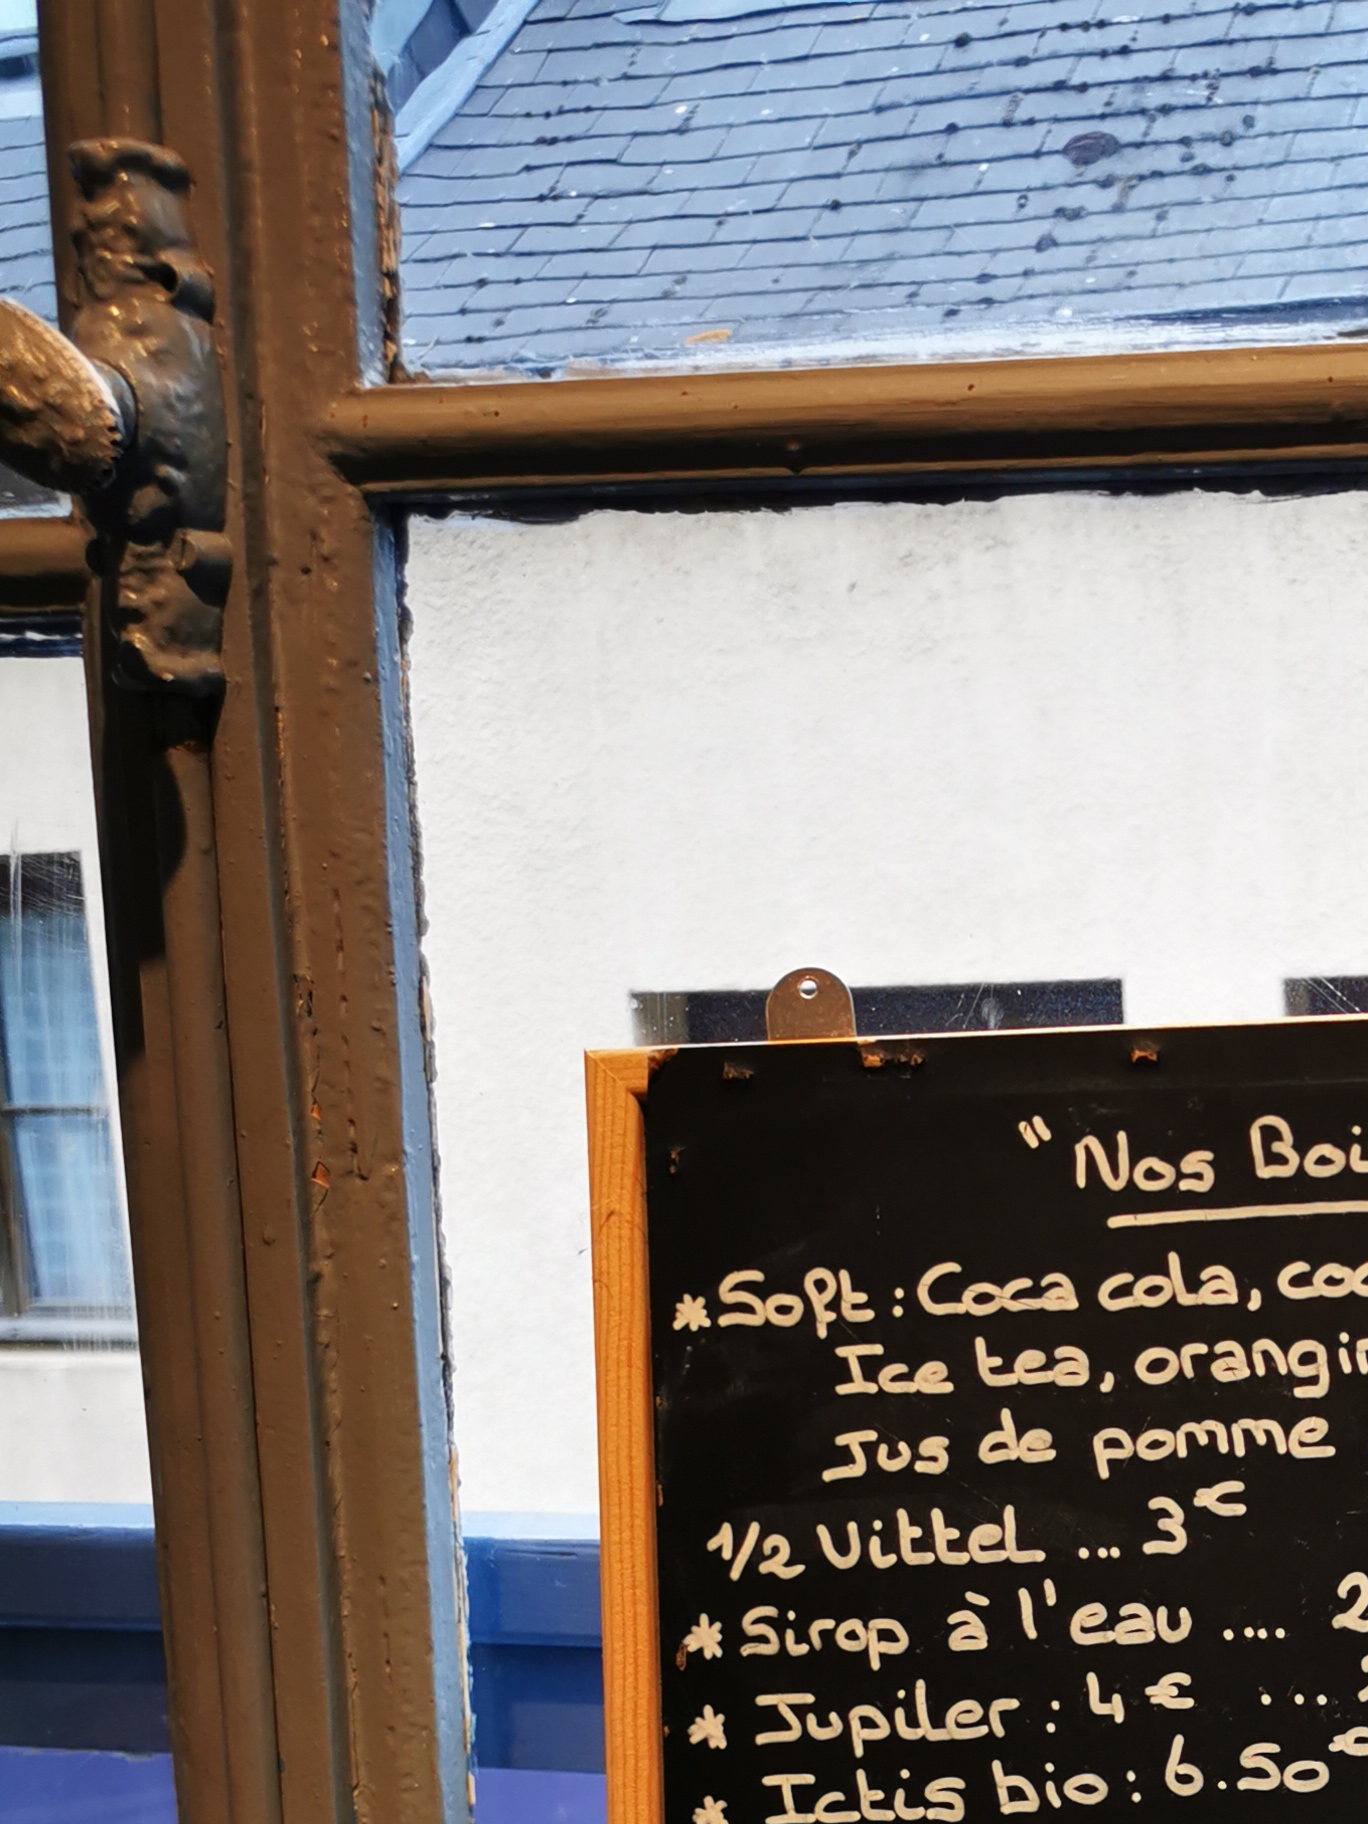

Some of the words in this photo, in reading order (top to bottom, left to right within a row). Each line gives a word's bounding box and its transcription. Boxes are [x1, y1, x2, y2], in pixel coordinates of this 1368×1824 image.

[917, 1262, 1079, 1316] Coca
[1098, 1251, 1261, 1311] cola,
[835, 1344, 954, 1395] Ice
[975, 1337, 1114, 1392] tea,
[822, 1430, 949, 1482] Jus
[979, 1408, 1056, 1464] de
[1093, 1416, 1336, 1479] pomme
[707, 1522, 805, 1580] 1/2
[740, 1606, 909, 1670] Sirop
[947, 1591, 989, 1651] à
[1018, 1579, 1192, 1645] l'eau
[762, 1769, 965, 1824] Ictis
